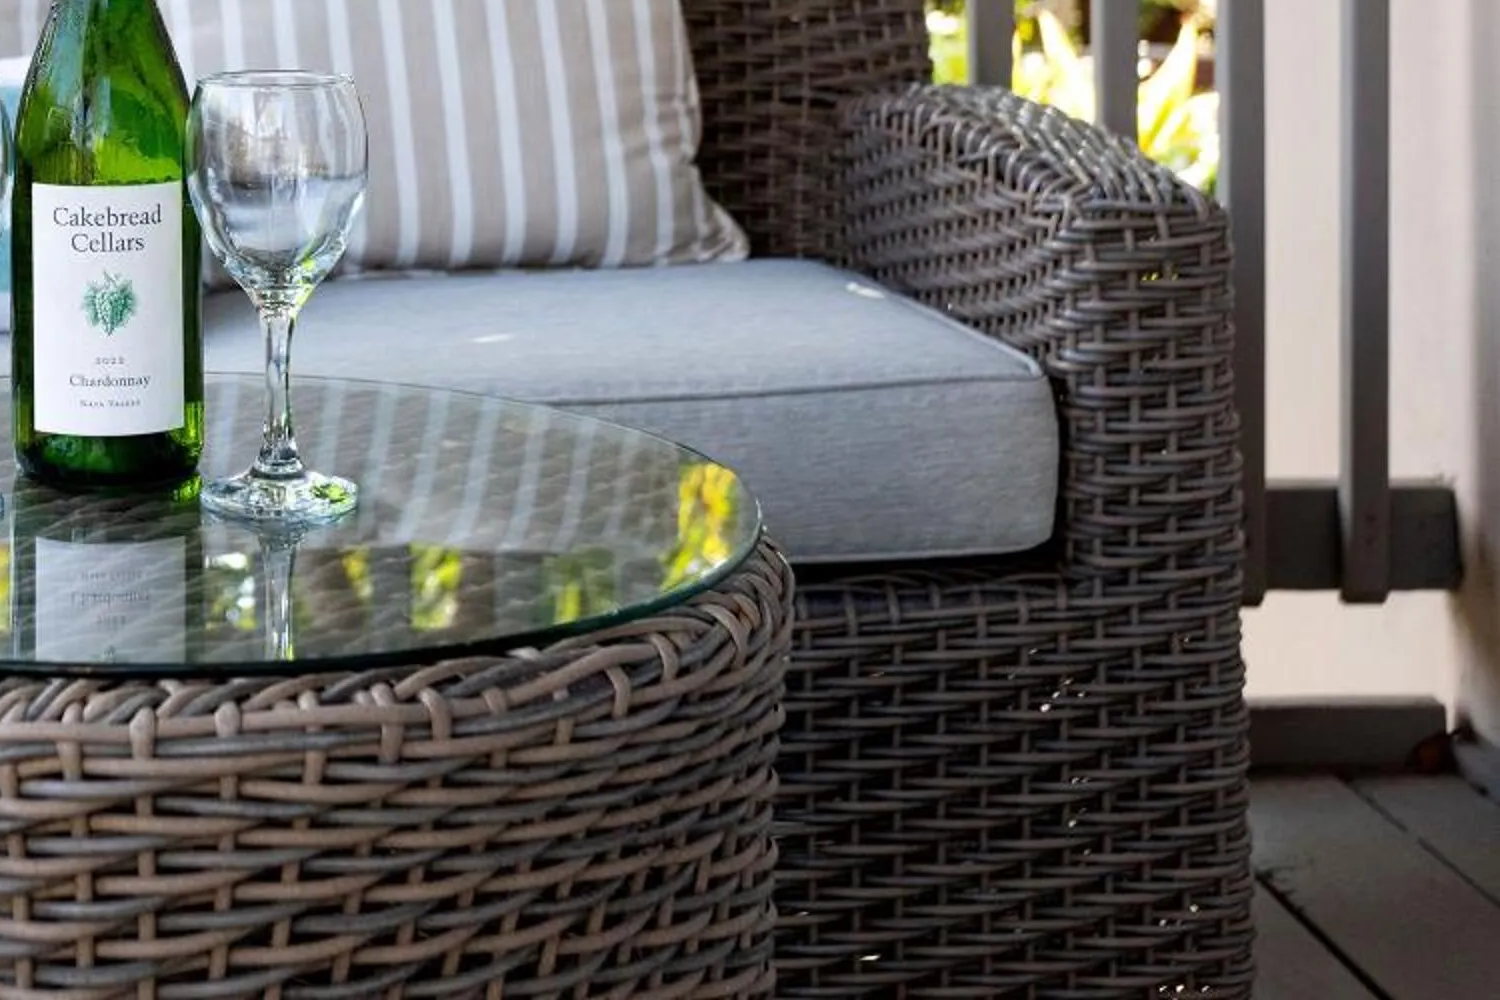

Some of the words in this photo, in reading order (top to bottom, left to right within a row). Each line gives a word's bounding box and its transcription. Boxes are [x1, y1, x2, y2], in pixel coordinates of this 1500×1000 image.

[52, 203, 162, 227] Cakebread
[71, 231, 145, 253] Cellars
[69, 374, 151, 390] Chardonnay
